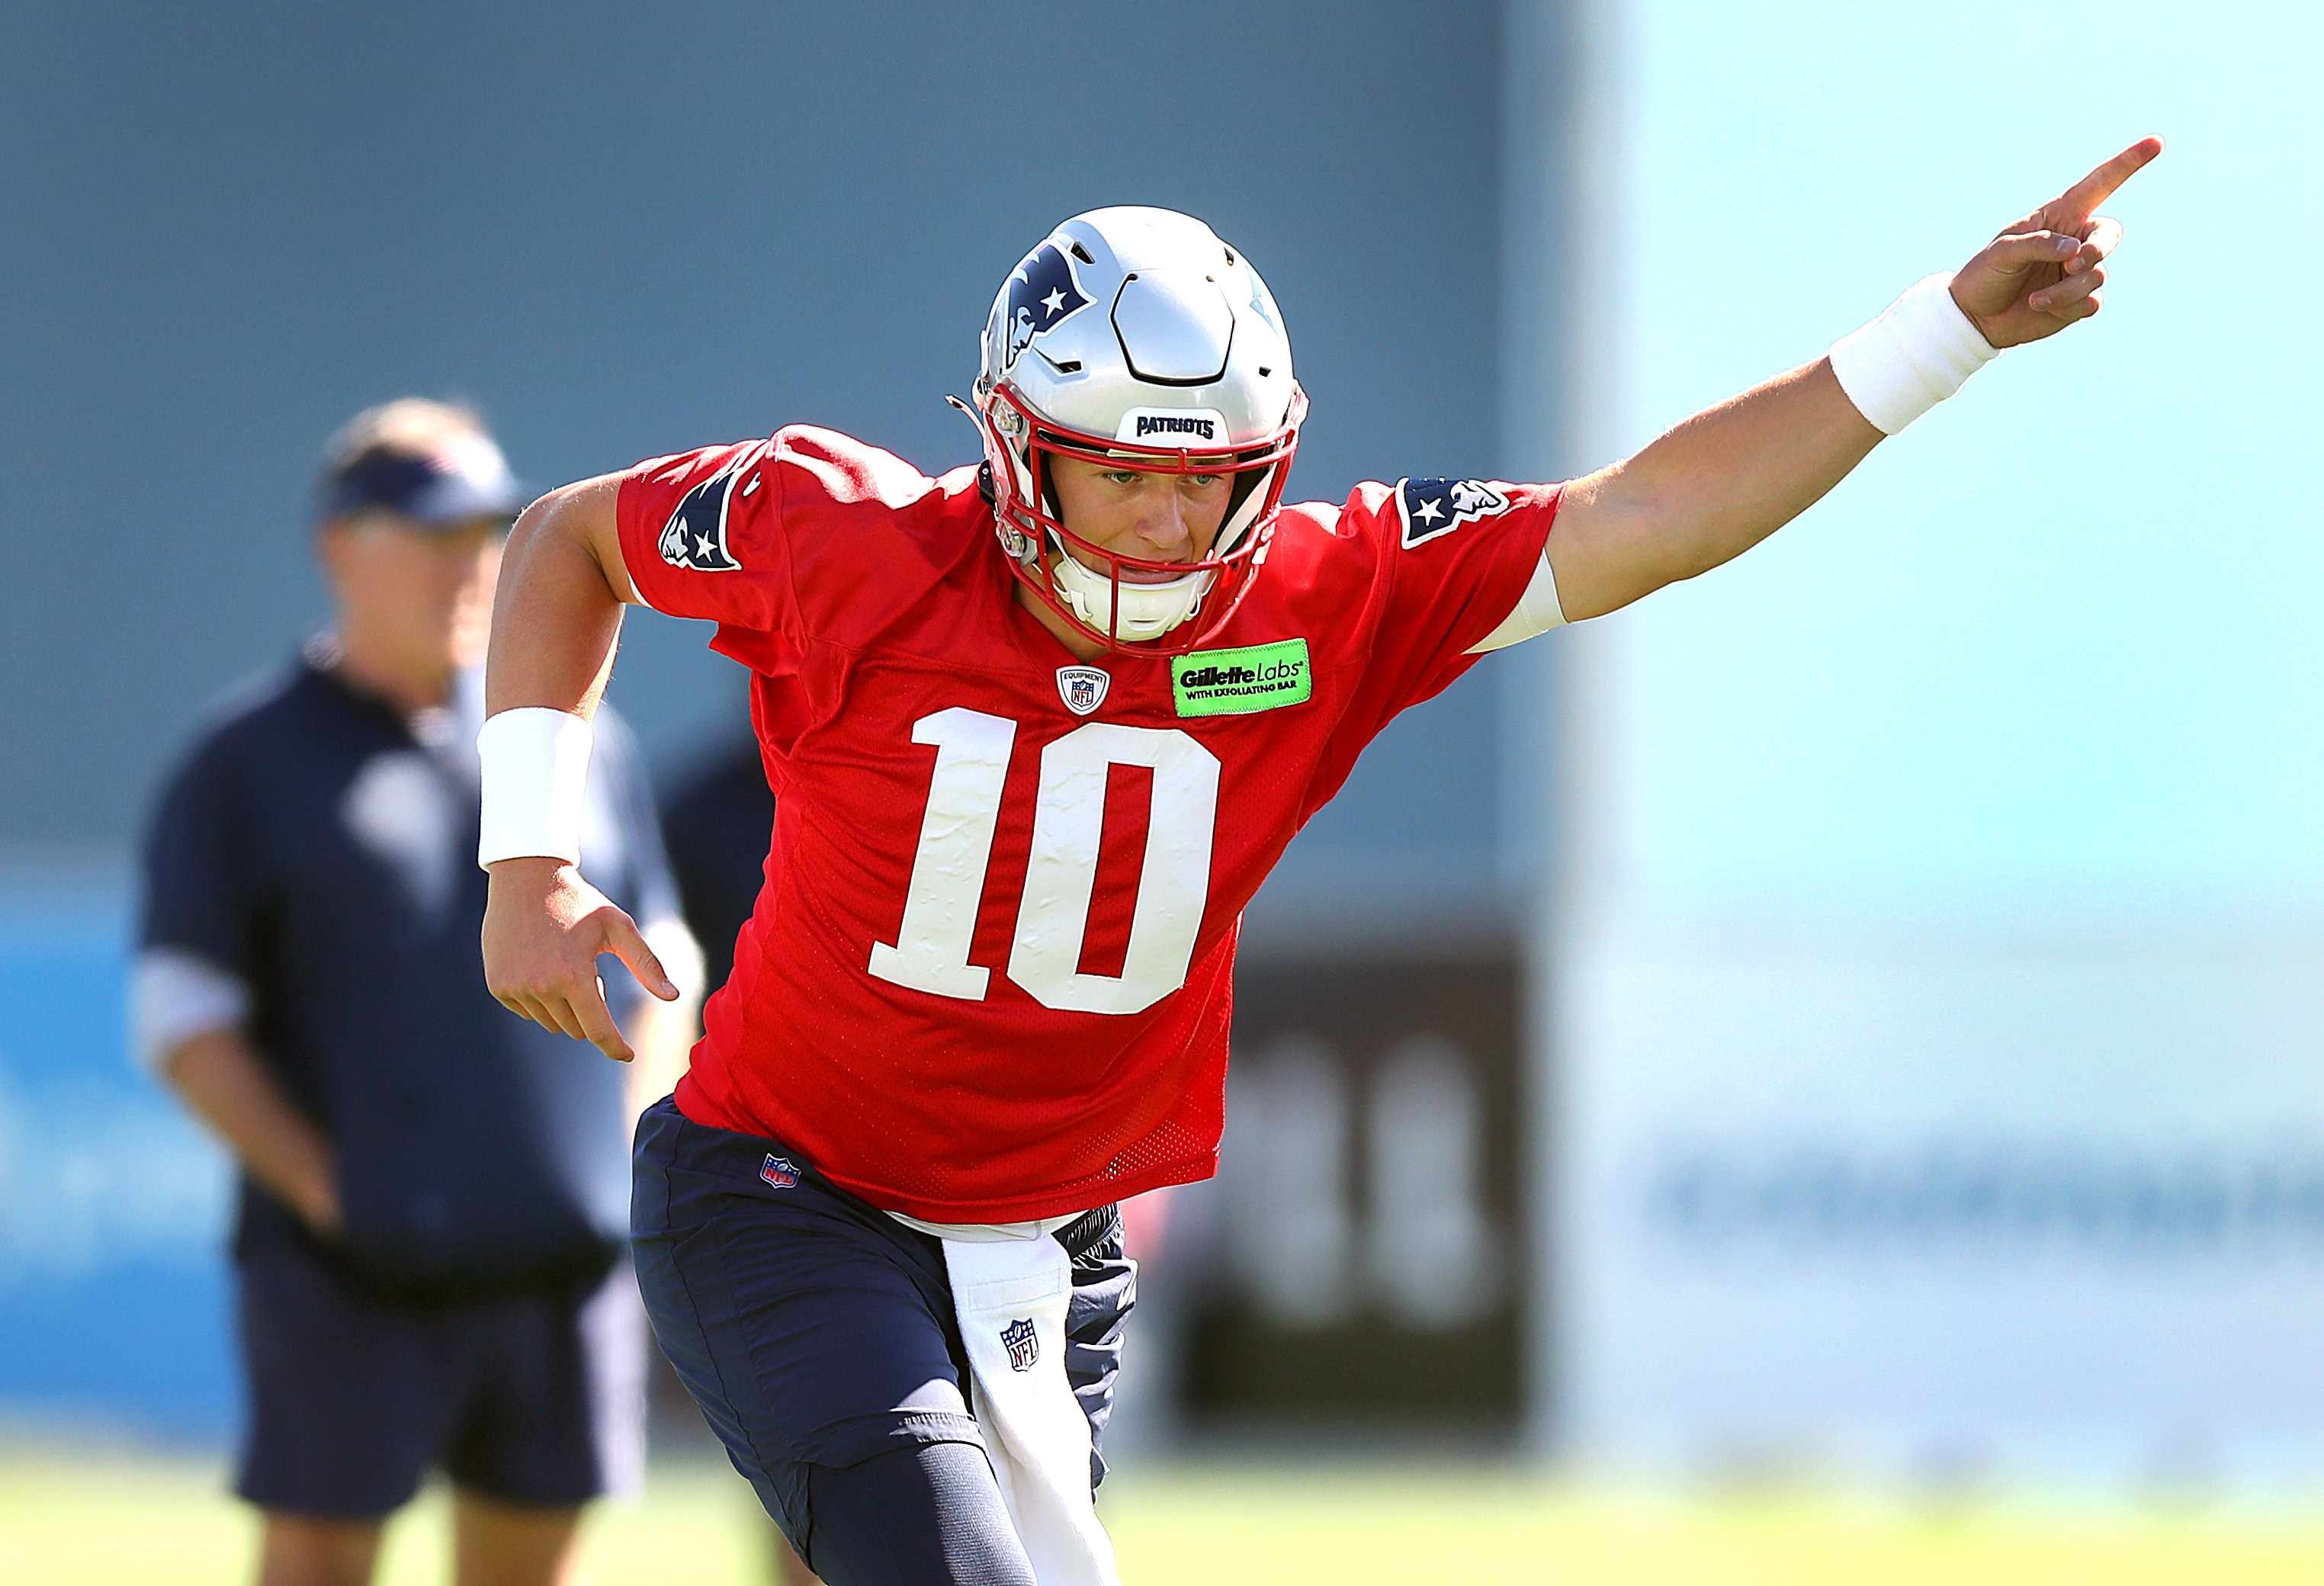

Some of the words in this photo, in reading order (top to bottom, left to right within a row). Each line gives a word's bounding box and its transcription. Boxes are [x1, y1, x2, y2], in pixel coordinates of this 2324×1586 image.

[1137, 416, 1215, 439] PATRIOTS
[1064, 673, 1103, 683] EQUIPMENT
[1074, 690, 1092, 704] NFL
[1186, 689, 1212, 700] WITH
[1214, 684, 1276, 697] EXFOLIATING
[1277, 680, 1297, 690] BAR
[868, 707, 1221, 1015] 10
[764, 1167, 794, 1184] NFL
[1010, 1338, 1037, 1367] NFL
